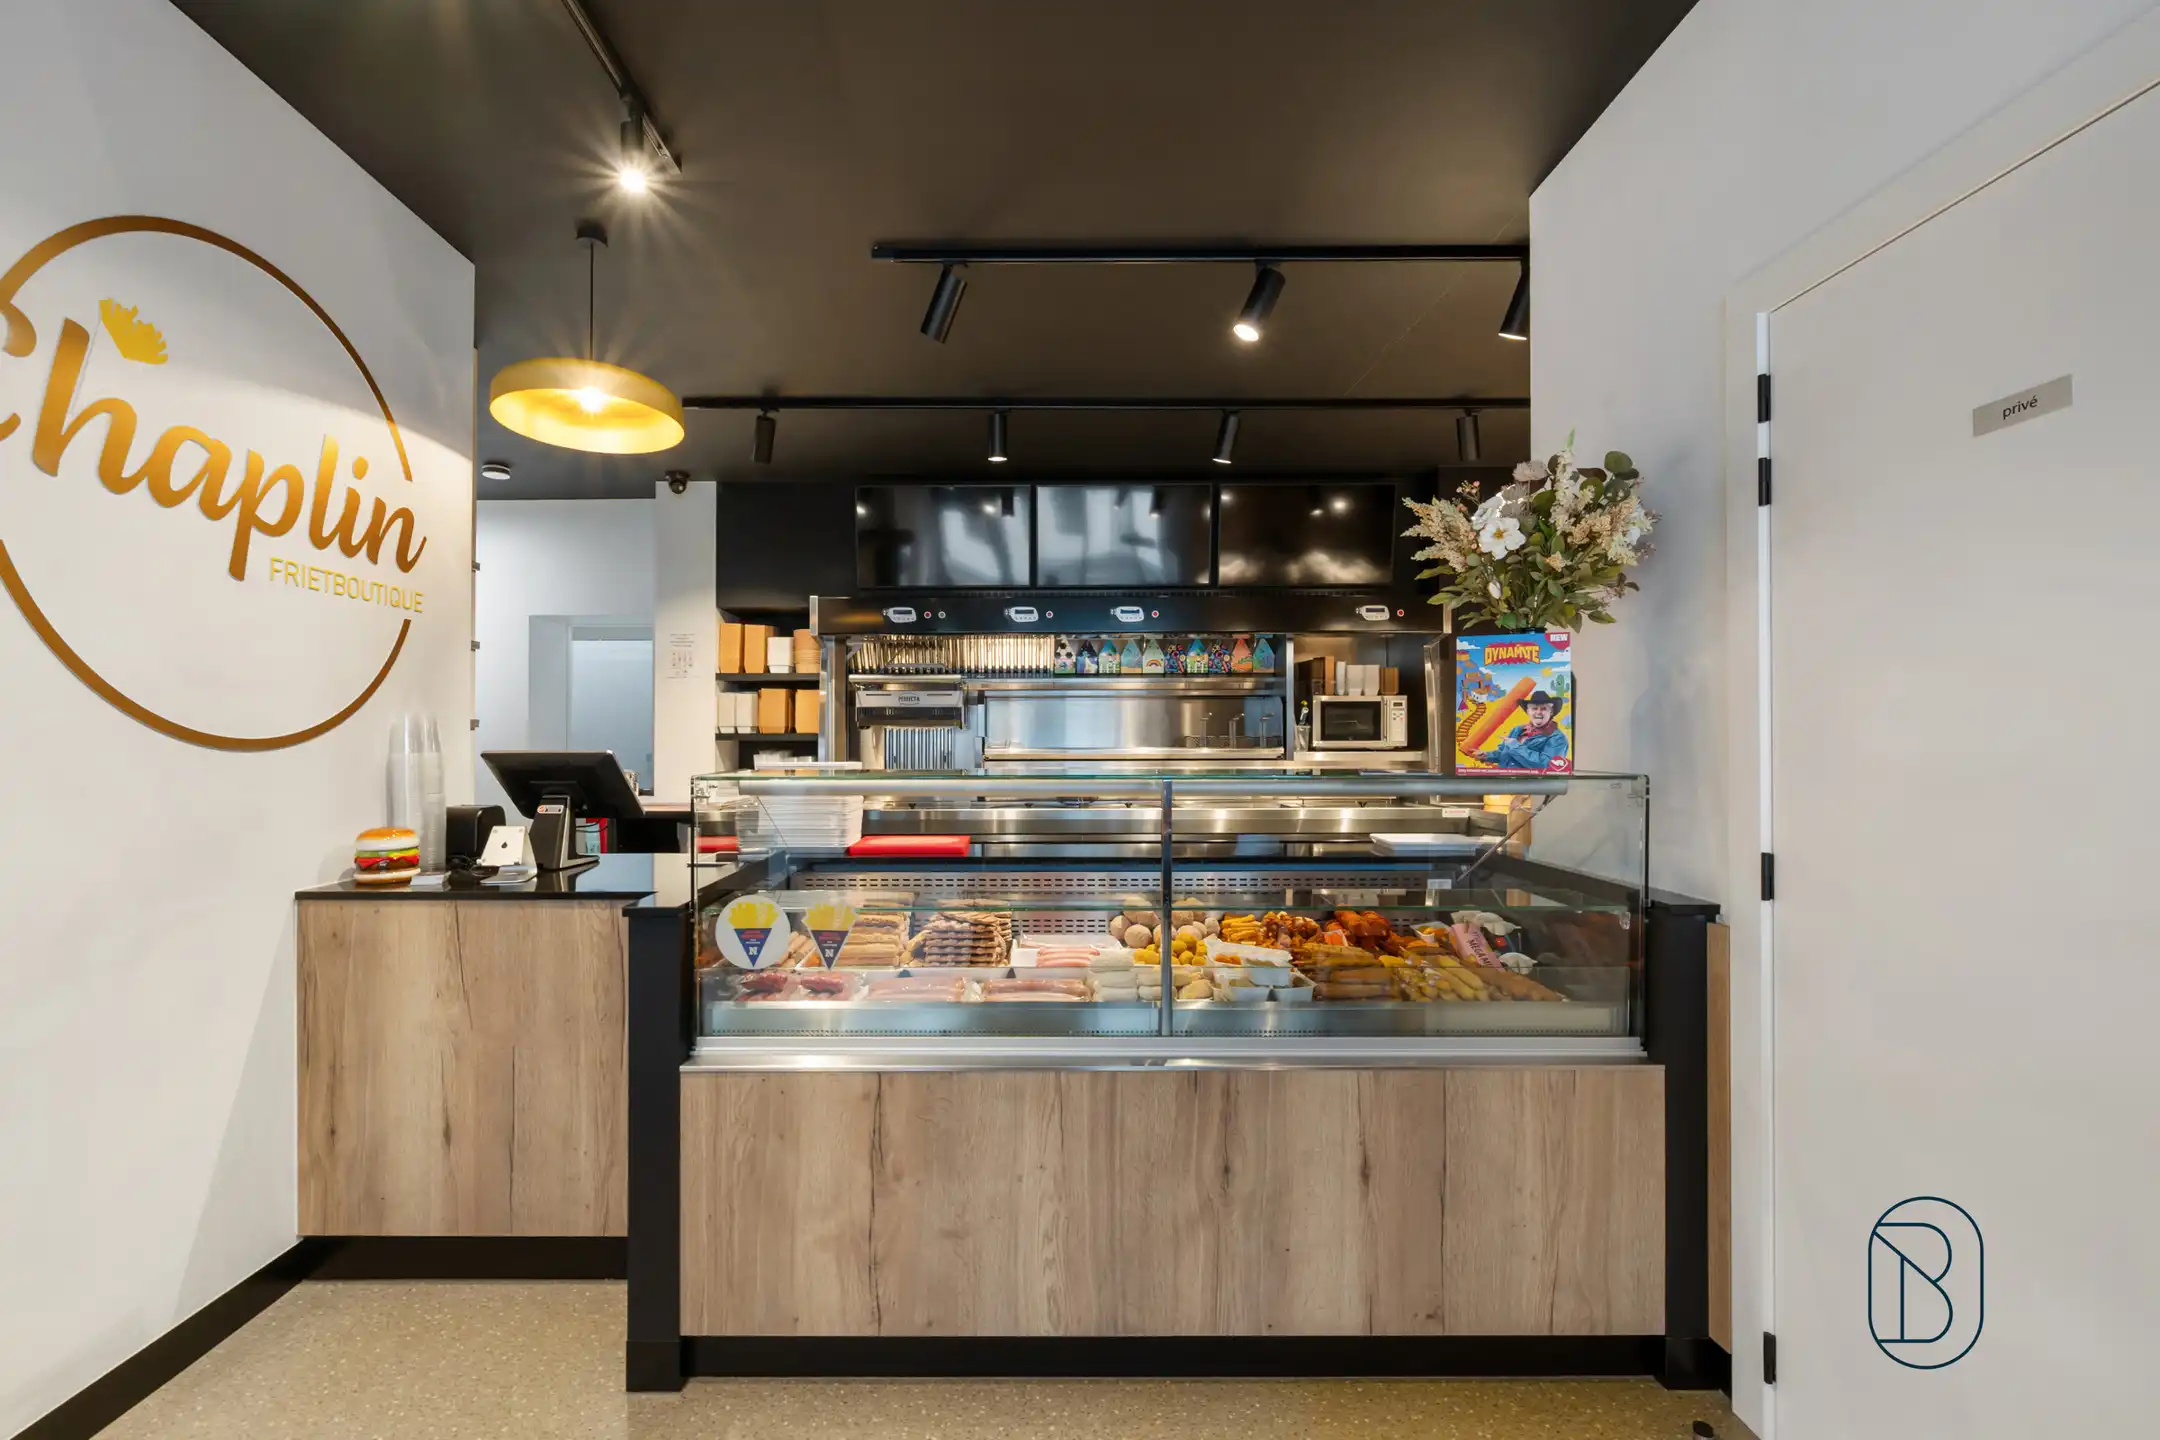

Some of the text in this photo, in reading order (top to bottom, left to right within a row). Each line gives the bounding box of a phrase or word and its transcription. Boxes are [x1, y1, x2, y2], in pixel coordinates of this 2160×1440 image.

[2002, 394, 2039, 420] privé
[270, 556, 425, 613] FRIETBOUTIQUE
[1550, 633, 1569, 642] NEW
[1484, 644, 1541, 666] DYNAMITE
